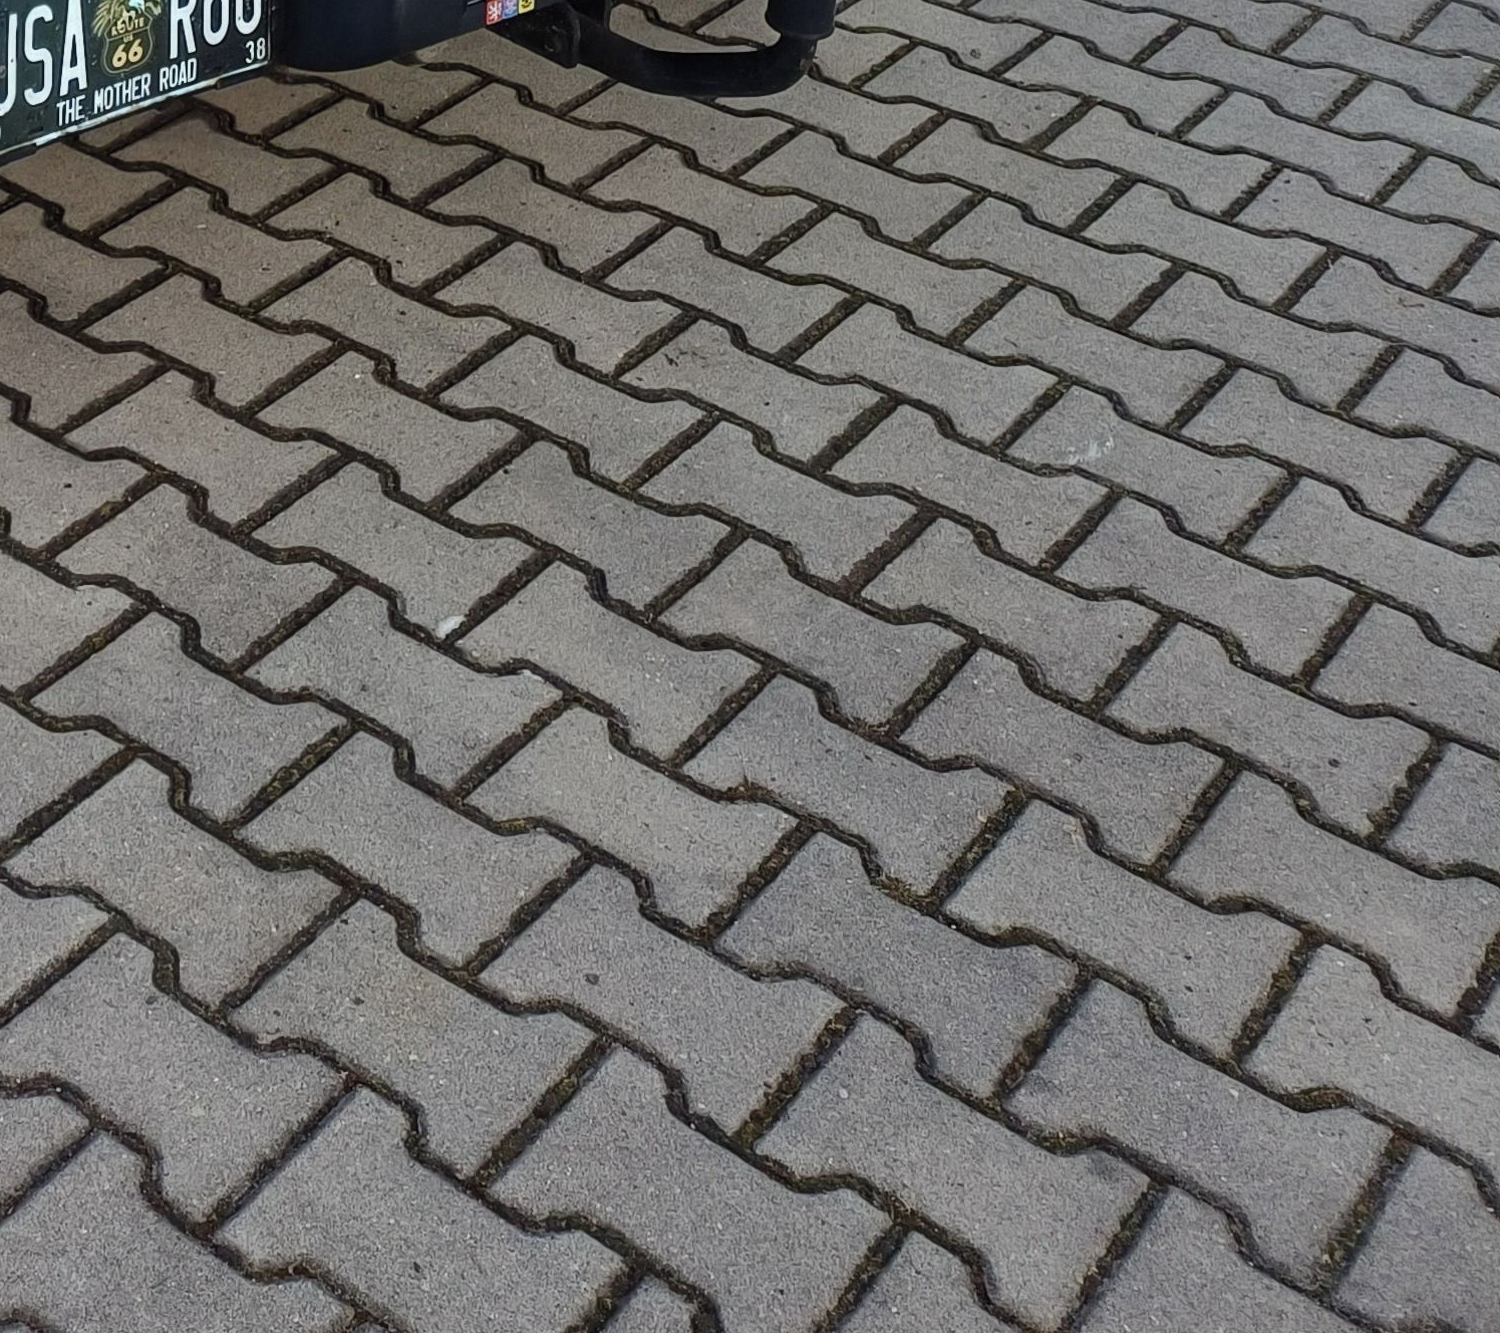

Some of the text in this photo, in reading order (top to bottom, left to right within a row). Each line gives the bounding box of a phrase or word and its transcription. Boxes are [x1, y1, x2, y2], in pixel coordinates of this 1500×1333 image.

[112, 38, 143, 68] 66
[245, 37, 266, 64] 38
[56, 57, 197, 127] THE MOTHER ROAD
